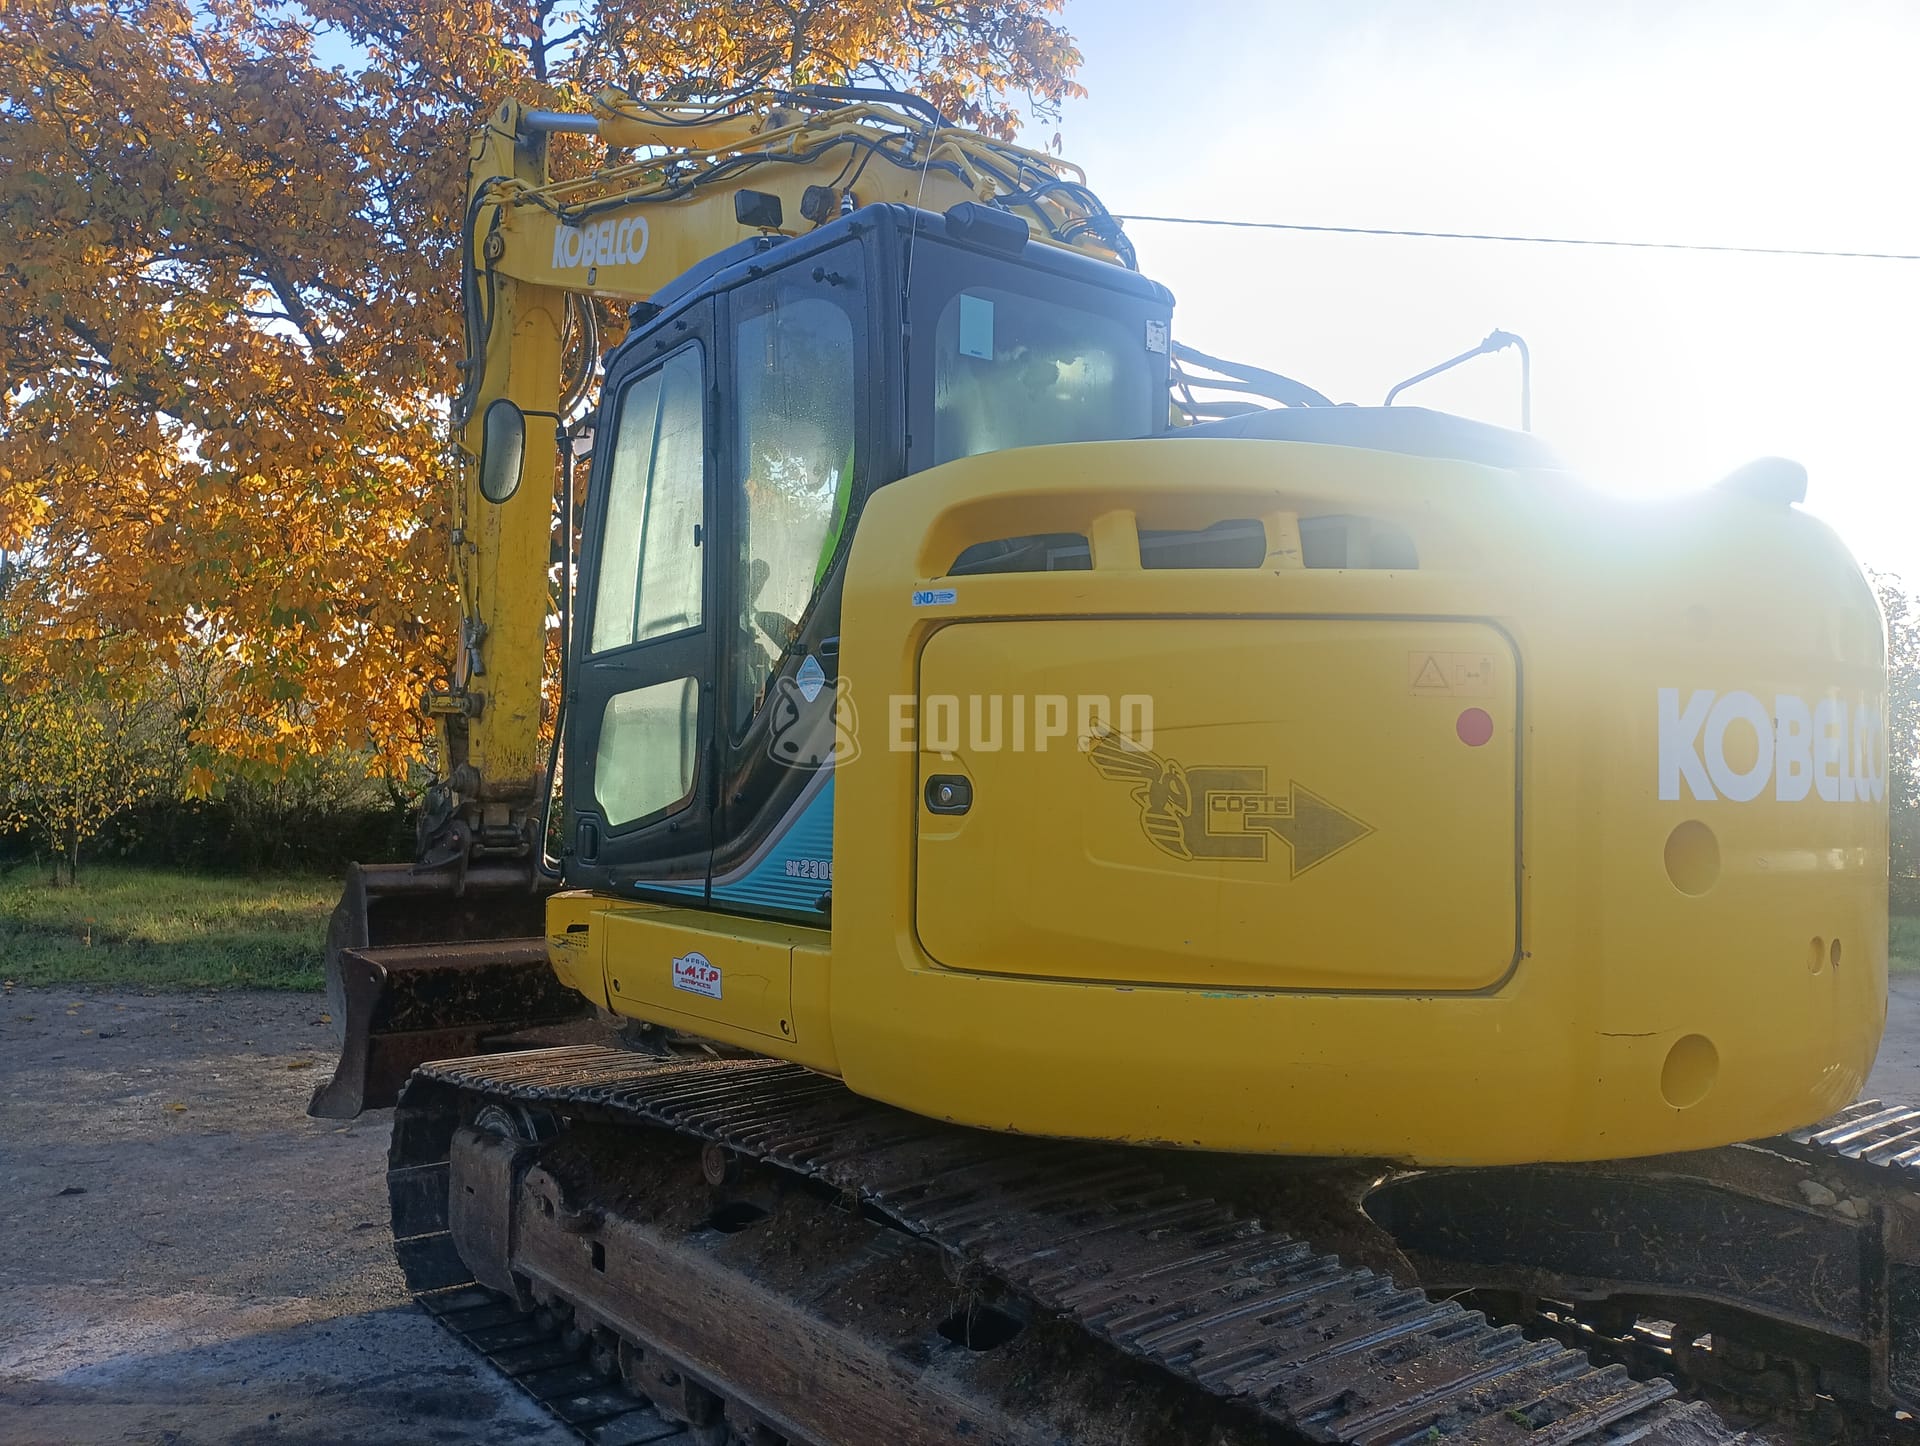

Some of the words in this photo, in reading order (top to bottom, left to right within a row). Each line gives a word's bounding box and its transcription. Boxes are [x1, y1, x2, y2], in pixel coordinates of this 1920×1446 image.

[552, 216, 649, 269] KOBELCO
[1658, 687, 1886, 802] KOBELCO
[1211, 796, 1289, 813] COSTE
